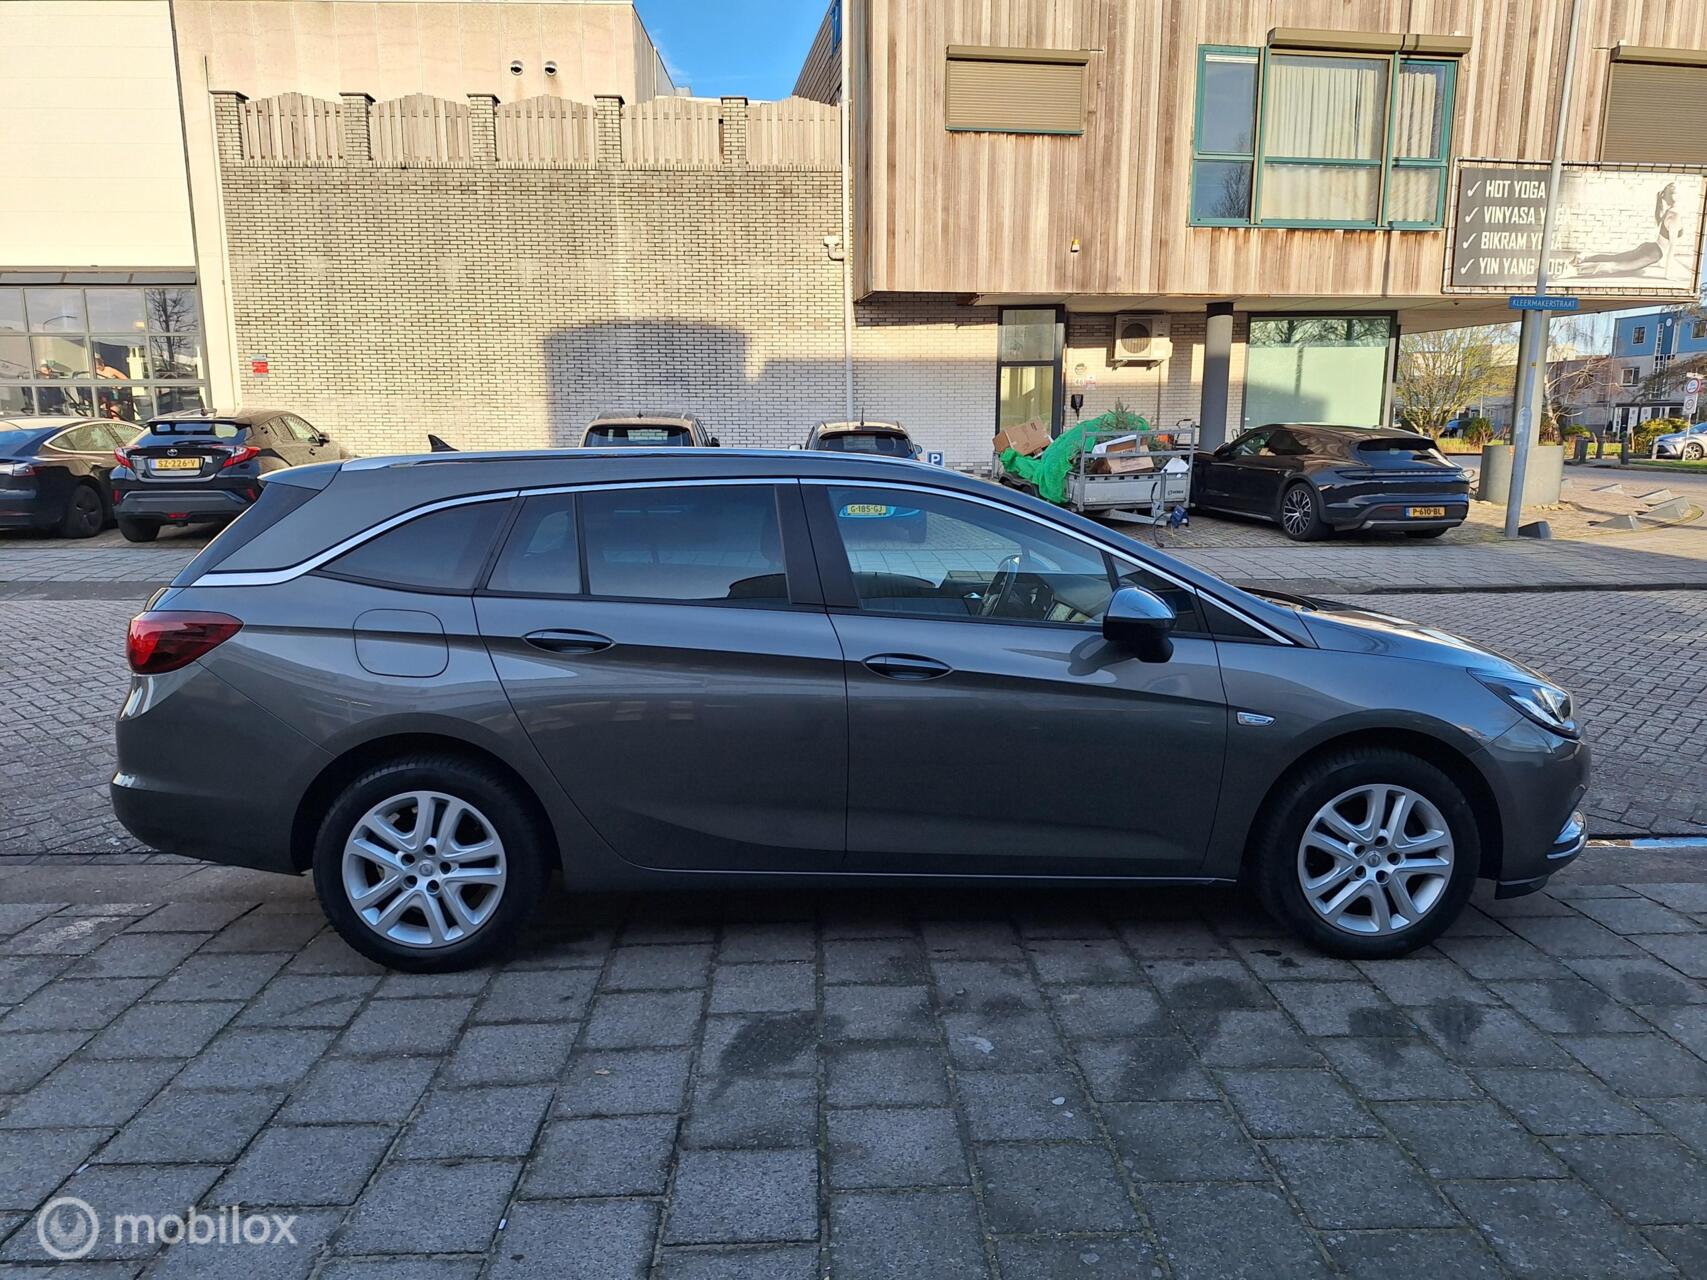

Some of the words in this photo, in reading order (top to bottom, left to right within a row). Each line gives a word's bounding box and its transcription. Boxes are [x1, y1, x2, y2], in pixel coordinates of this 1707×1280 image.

[1485, 180, 1511, 198] HOT
[1514, 180, 1546, 199] YOGA
[1484, 206, 1535, 224] VINYASA
[1539, 207, 1570, 225] YGA
[1481, 231, 1527, 250] BIKRAM
[1479, 257, 1499, 275] YIN
[1503, 257, 1535, 275] YANG
[1545, 258, 1570, 275] OGA
[1512, 299, 1576, 308] KLEERMAKERSTRAAT
[158, 459, 196, 468] SZ-226-V
[931, 453, 941, 465] P
[1412, 508, 1442, 516] P-610-BL
